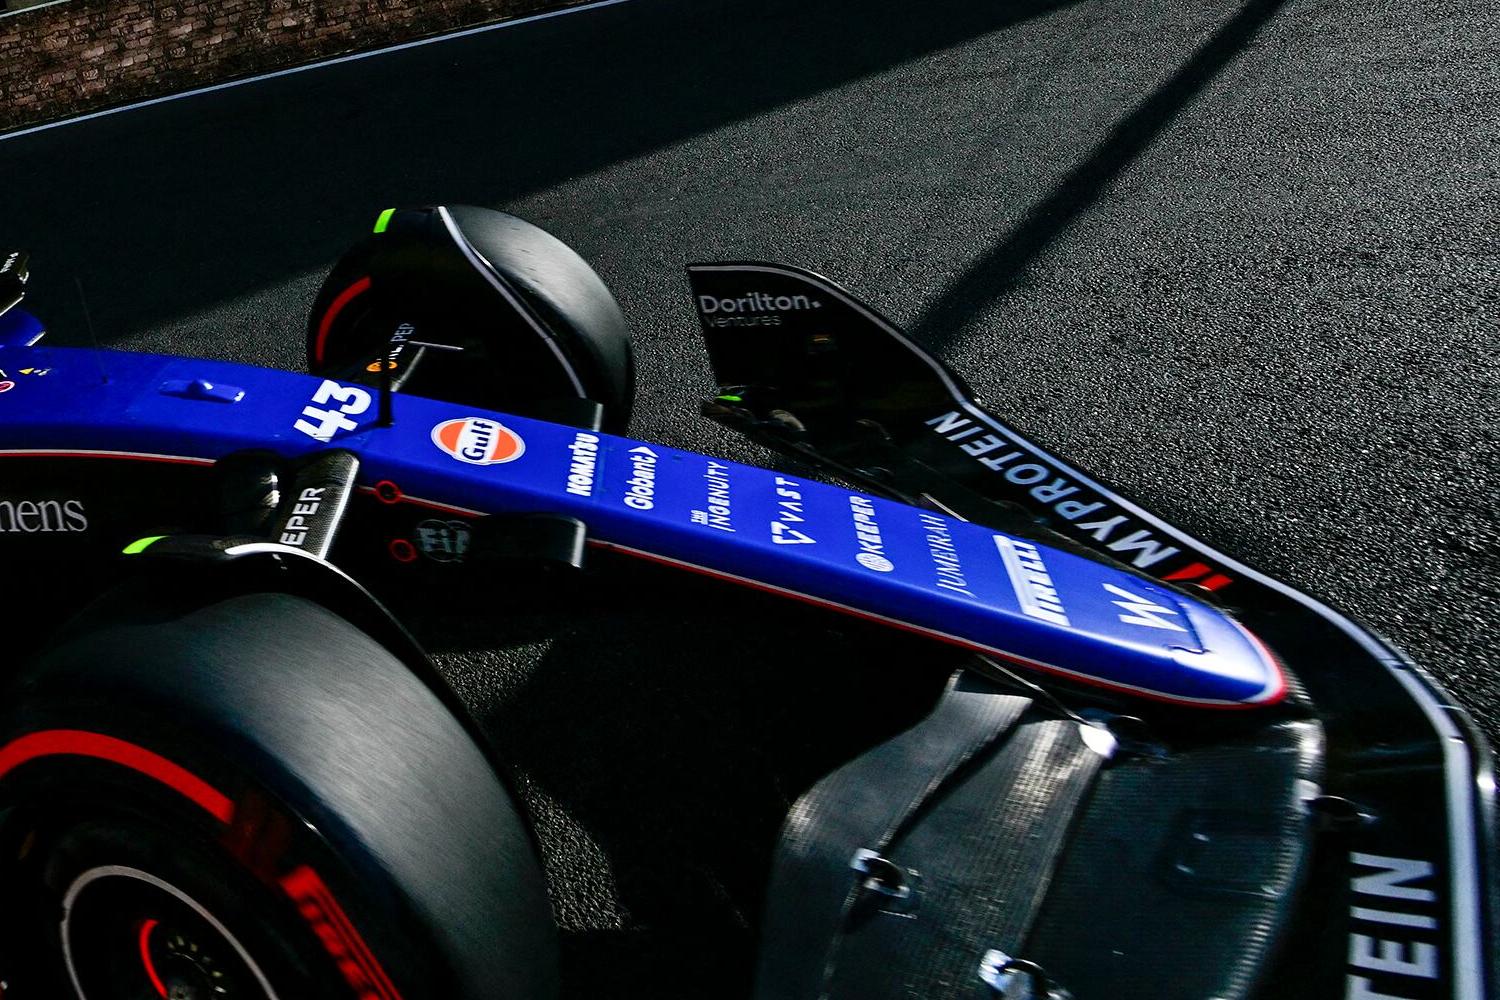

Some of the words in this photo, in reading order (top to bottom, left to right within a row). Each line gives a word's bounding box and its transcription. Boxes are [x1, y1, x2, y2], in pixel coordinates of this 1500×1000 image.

[703, 314, 783, 328] Ventures
[293, 379, 372, 443] 43
[461, 420, 494, 461] Gulf
[566, 432, 600, 497] KOMATSU
[623, 452, 658, 510] Globant
[924, 410, 1183, 569] MYPROTEIN
[280, 486, 326, 546] EPER
[703, 461, 737, 532] INGENUITY
[775, 477, 805, 522] VAST
[849, 496, 886, 555] KEEPER
[919, 513, 979, 599] JUMEIRAH
[992, 534, 1072, 627] PIRELLI
